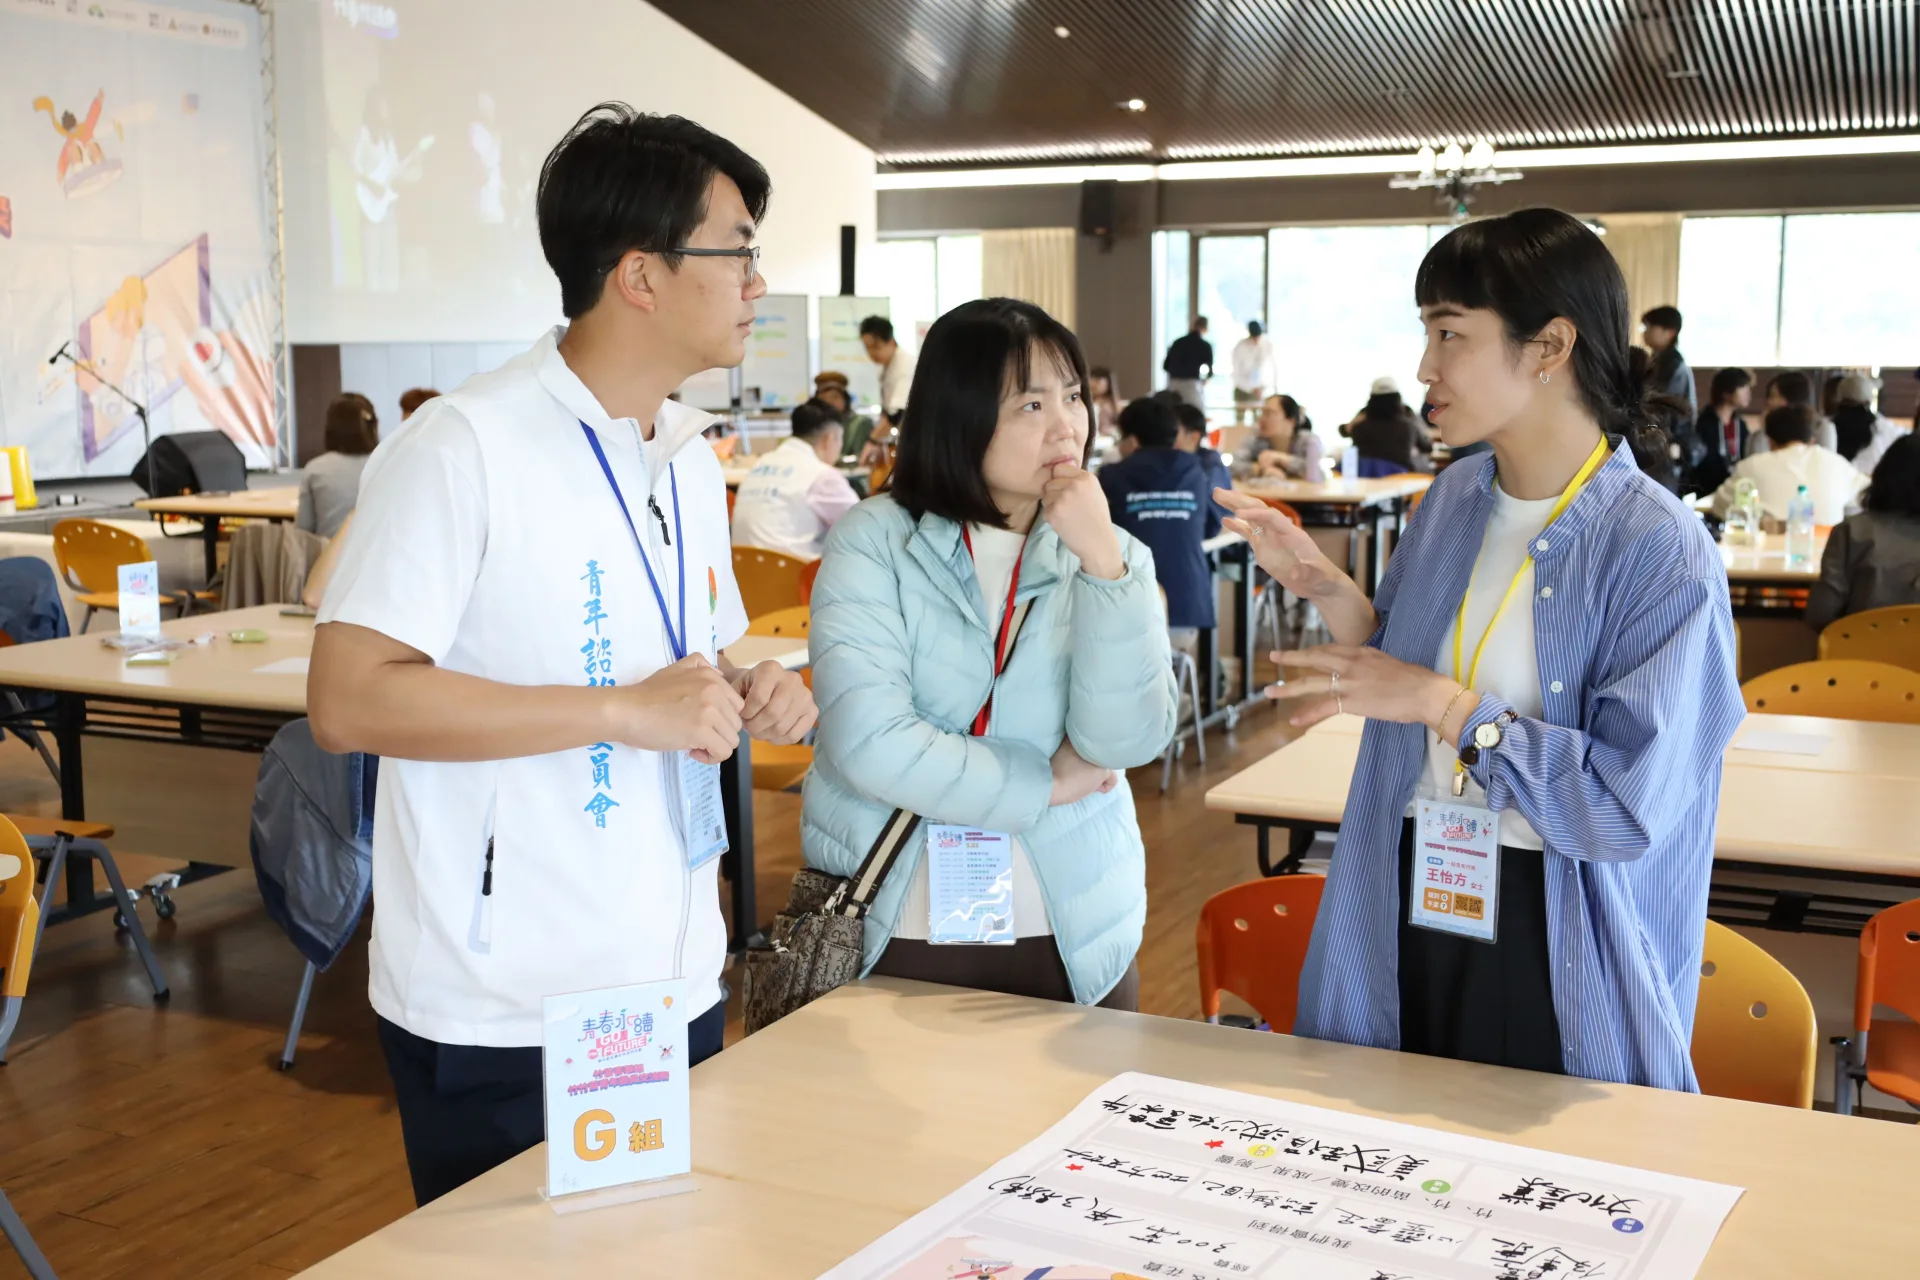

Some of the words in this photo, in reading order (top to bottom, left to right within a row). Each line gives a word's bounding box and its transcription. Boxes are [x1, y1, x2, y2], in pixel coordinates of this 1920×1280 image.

[580, 559, 620, 828] 青年諮員會
[1426, 867, 1467, 887] 王怡方
[600, 1031, 620, 1046] GO
[603, 1036, 645, 1056] FUTURE
[573, 1108, 617, 1162] G
[628, 1118, 665, 1154] 組
[1247, 1219, 1352, 1249] 我們會得到
